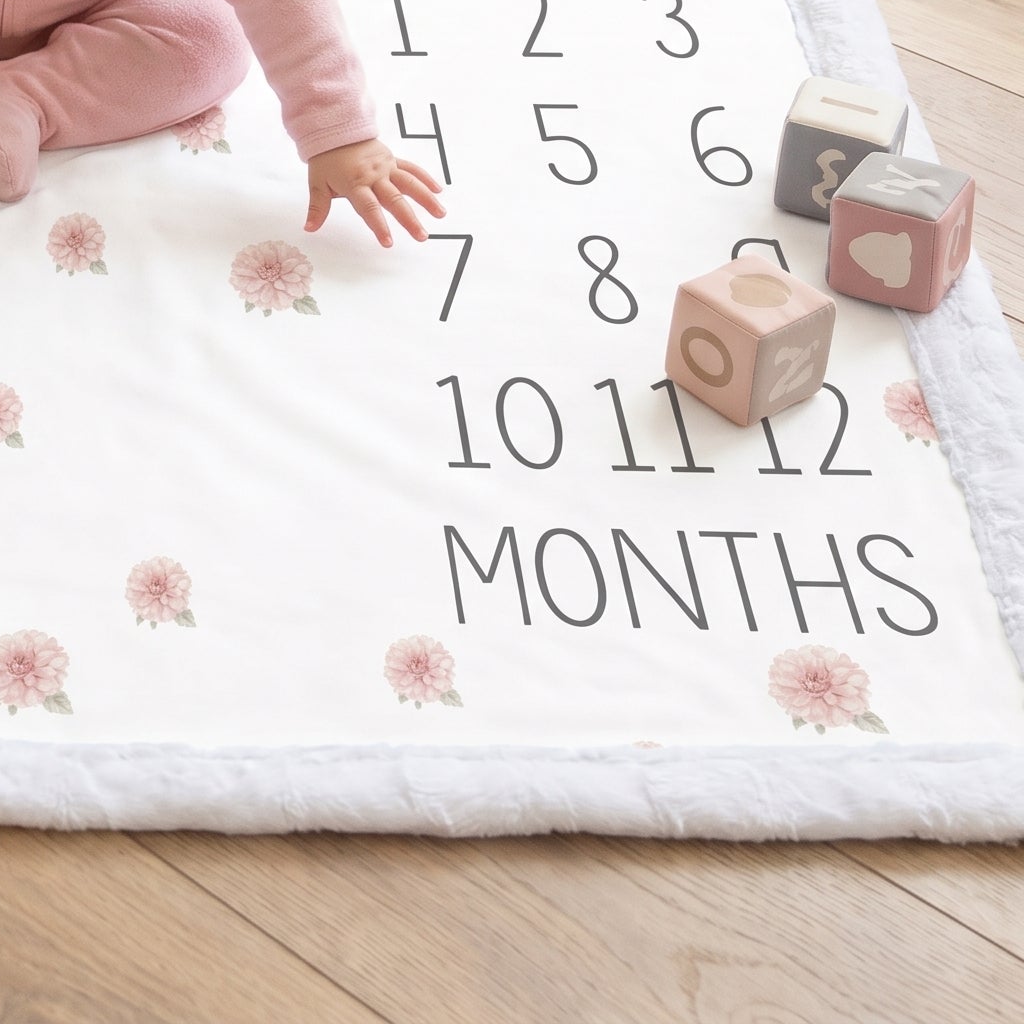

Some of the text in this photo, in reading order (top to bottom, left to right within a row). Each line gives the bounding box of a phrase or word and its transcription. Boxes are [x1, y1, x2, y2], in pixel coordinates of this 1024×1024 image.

[395, 102, 452, 186] 4
[532, 103, 598, 186] 5
[690, 105, 753, 187] 6
[427, 233, 474, 322] 7
[577, 234, 639, 325] 8
[436, 375, 563, 470] 10
[593, 378, 715, 474] 11
[443, 525, 939, 637] MONTHS
